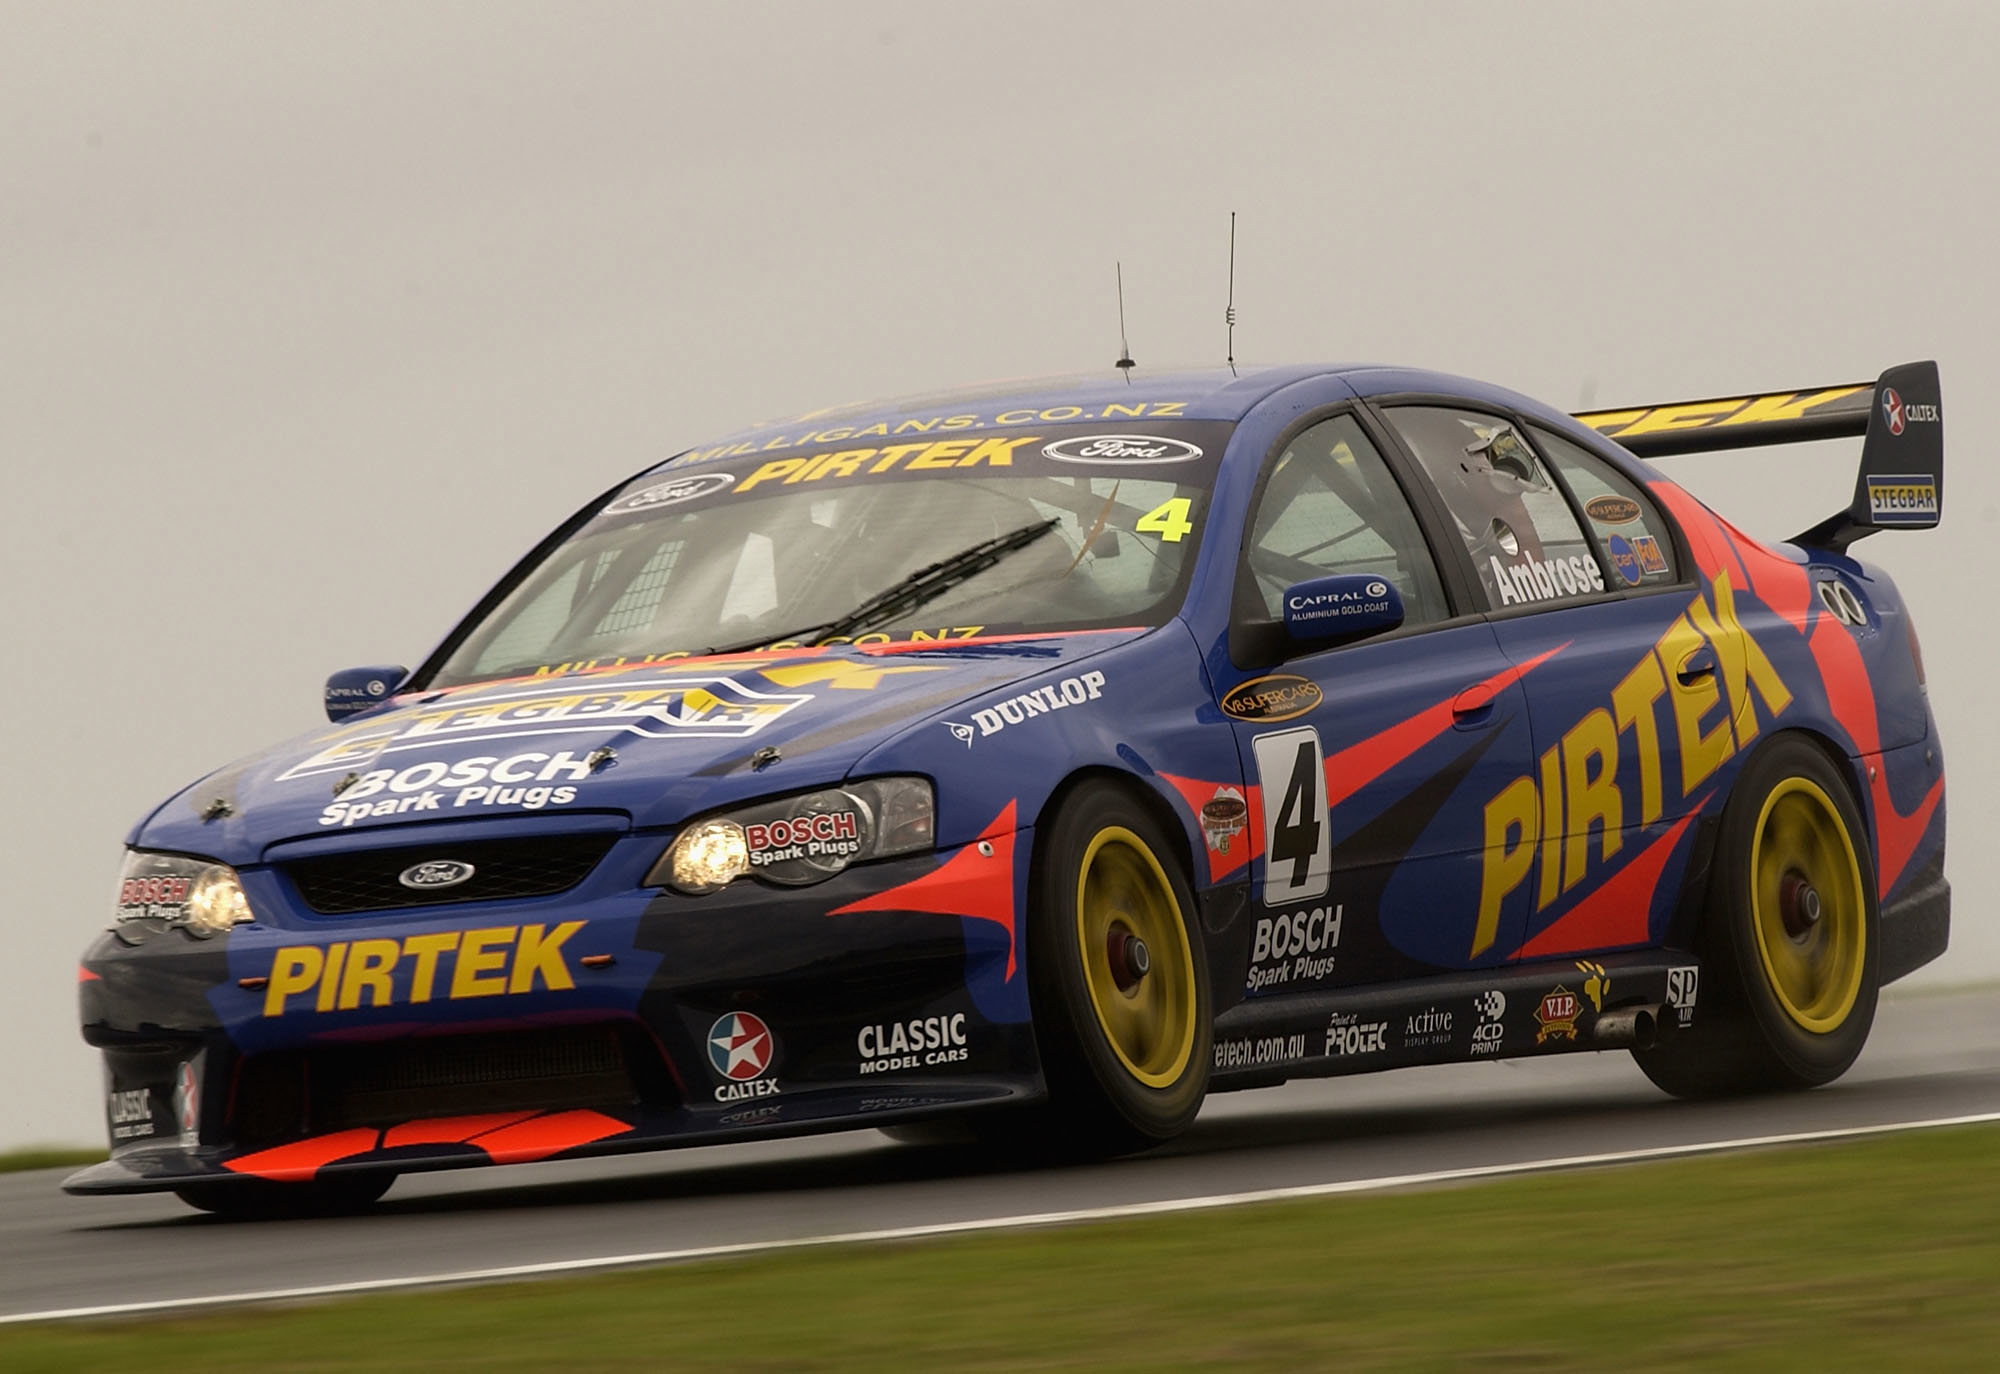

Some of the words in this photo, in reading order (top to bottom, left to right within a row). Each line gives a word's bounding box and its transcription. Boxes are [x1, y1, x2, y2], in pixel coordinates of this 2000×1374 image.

[1905, 404, 1939, 422] CALTEX
[673, 402, 1188, 467] MILLIGANS.CO.NZ
[1080, 439, 1167, 458] Ford
[732, 436, 1043, 494] PIRTEK
[628, 481, 706, 507] Ford
[1874, 488, 1934, 508] STEGBAR
[1135, 497, 1192, 542] 4
[1489, 550, 1604, 606] Ambrose
[1289, 591, 1363, 610] CAPRAL
[1291, 608, 1340, 622] ALUMINIUM
[1341, 603, 1363, 616] GOLD
[1364, 601, 1390, 613] COAST
[971, 670, 1106, 737] DUNLOP
[1224, 698, 1247, 713] V8
[1242, 682, 1320, 710] SUPERCARS
[333, 751, 594, 802] BOSCH
[1470, 567, 1794, 960] PIRTEK
[317, 791, 445, 827] Spark
[453, 784, 578, 809] Plugs
[1271, 740, 1321, 889] 4
[745, 812, 857, 852] BOSCH
[750, 845, 804, 866] Spark
[808, 840, 859, 856] Plugs
[119, 877, 191, 906] BOSCH
[1252, 904, 1343, 963] BOSCH
[262, 920, 590, 1017] PIRTEK
[1246, 960, 1291, 992] Spark
[1293, 956, 1335, 987] Plugs
[1668, 970, 1696, 1005] SP
[1405, 1007, 1453, 1035] Active
[1546, 996, 1574, 1017] V.I.P.
[857, 1013, 967, 1058] CLASSIC
[1325, 1022, 1388, 1057] PROTEC
[1404, 1038, 1430, 1048] DISPLAY
[1470, 1040, 1502, 1056] PRINT
[1473, 1023, 1504, 1042] 4CD
[860, 1057, 920, 1074] MODEL
[925, 1048, 968, 1064] CARS
[1213, 1034, 1305, 1067] etech.com.au
[714, 1077, 781, 1102] CALTEX
